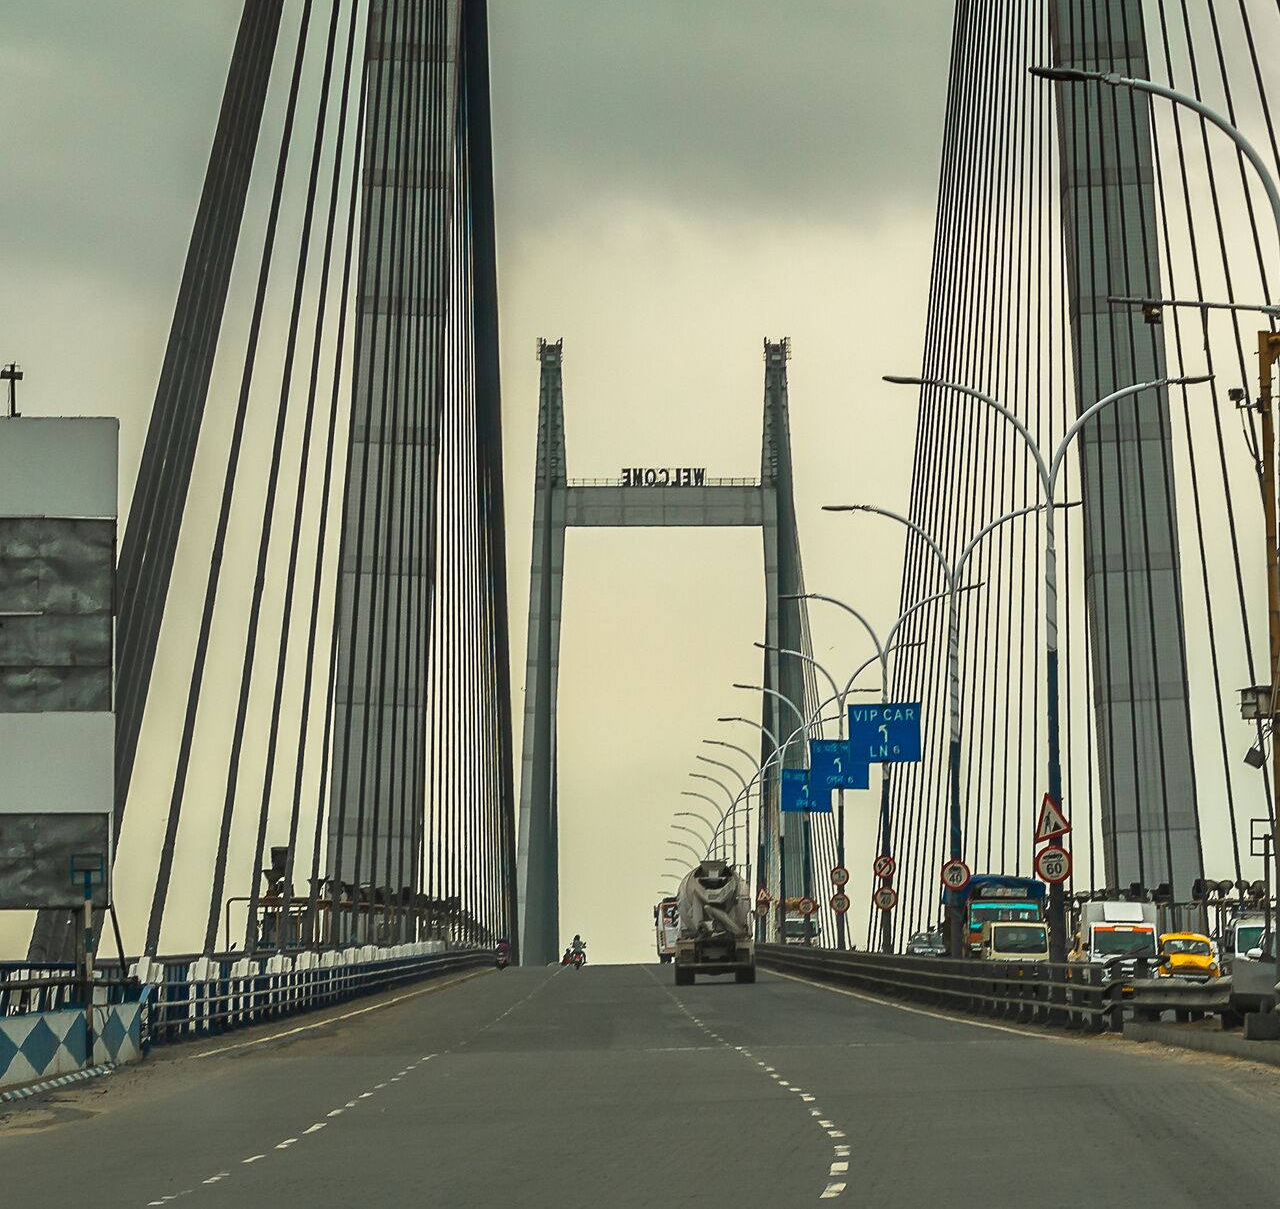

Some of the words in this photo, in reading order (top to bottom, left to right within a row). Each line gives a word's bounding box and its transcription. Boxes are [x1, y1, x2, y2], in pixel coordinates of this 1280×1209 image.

[853, 709, 878, 722] VIP
[883, 708, 914, 721] CAR
[869, 745, 888, 758] LN
[1046, 862, 1063, 875] 60
[949, 872, 963, 884] 40
